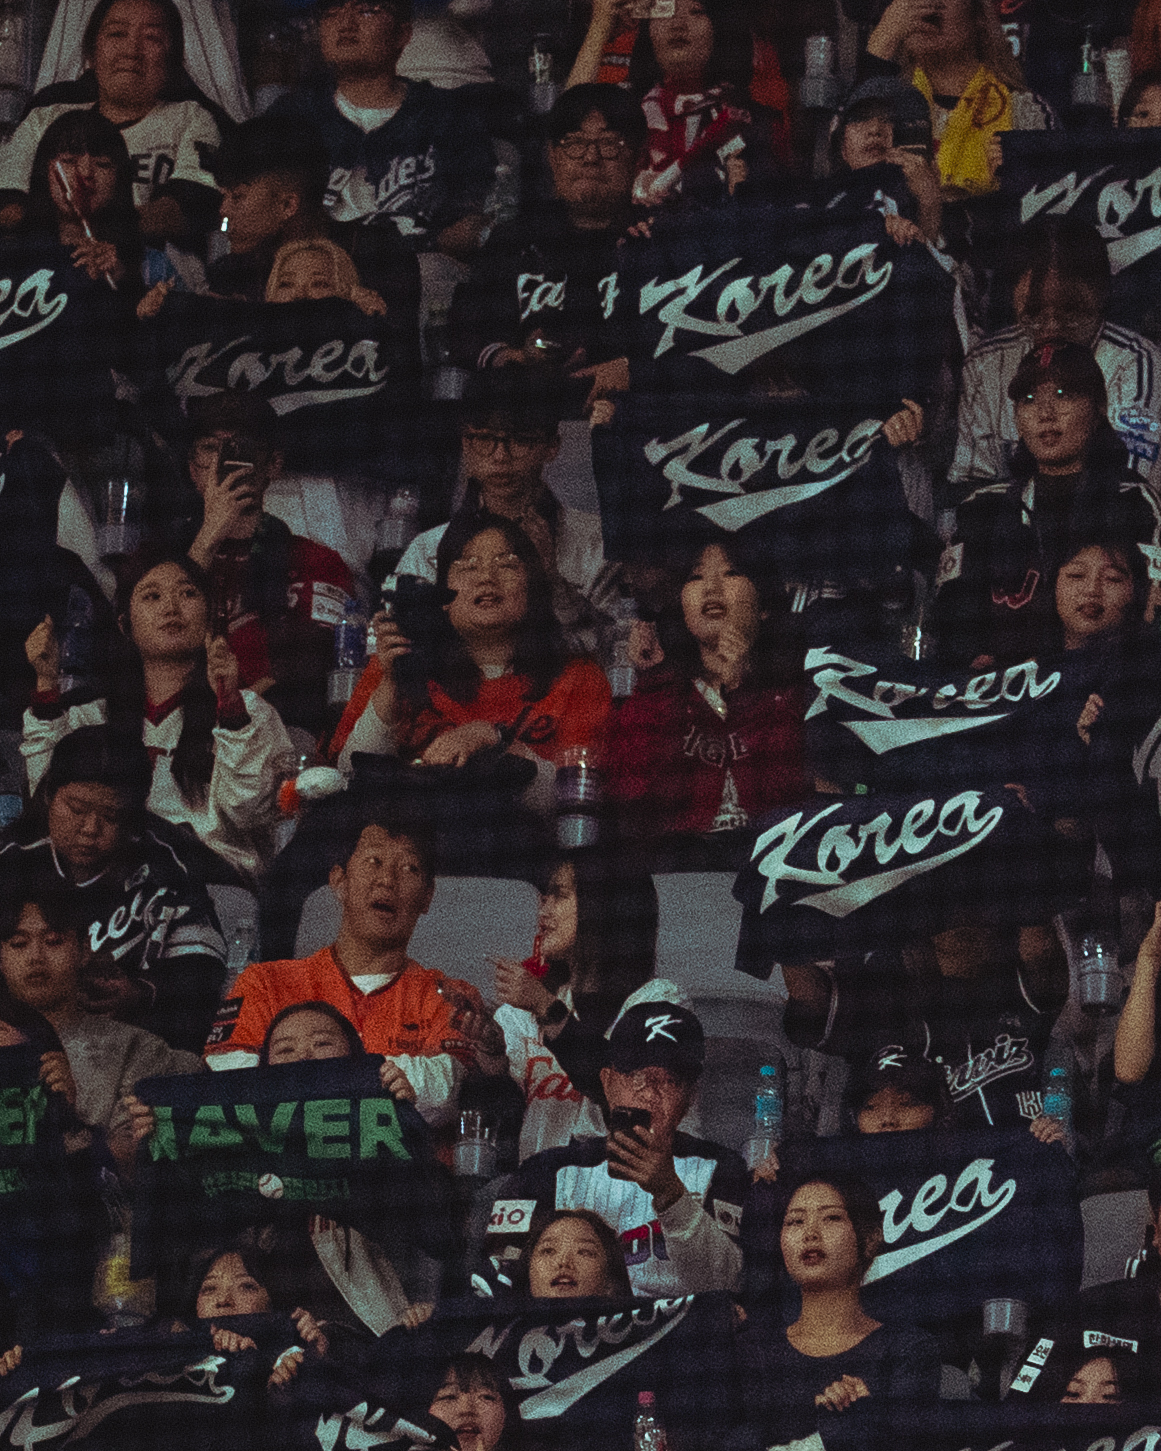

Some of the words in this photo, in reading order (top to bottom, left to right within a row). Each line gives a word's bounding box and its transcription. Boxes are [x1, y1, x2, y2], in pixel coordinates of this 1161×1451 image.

[640, 243, 893, 360] Korea
[168, 334, 390, 414] Korea
[750, 791, 1003, 914] Korea
[878, 1157, 1016, 1245] rea
